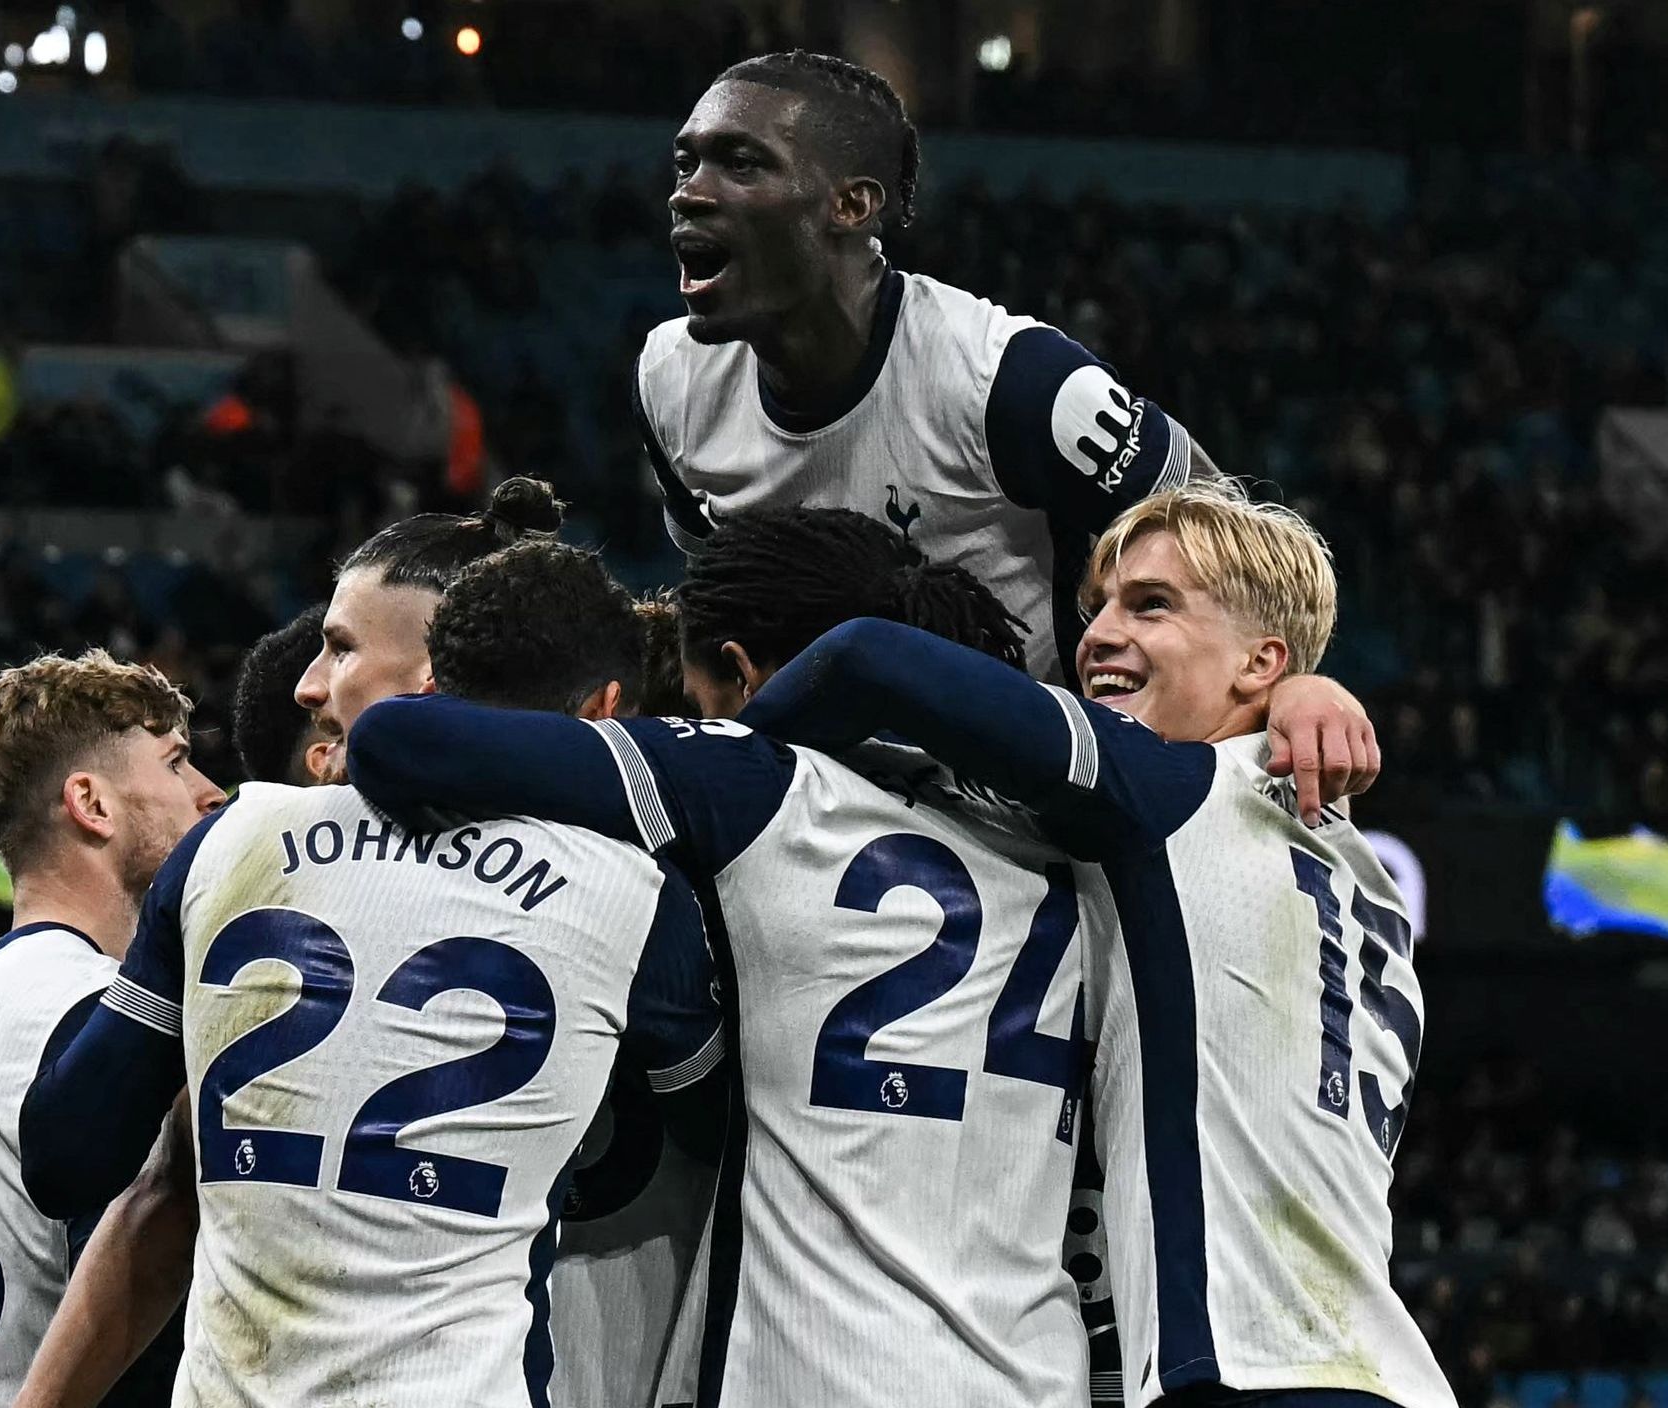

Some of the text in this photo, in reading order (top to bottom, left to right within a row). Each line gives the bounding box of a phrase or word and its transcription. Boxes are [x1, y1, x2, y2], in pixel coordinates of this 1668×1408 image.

[282, 819, 568, 912] JOHNSON
[809, 832, 1084, 1146] 24
[1292, 845, 1425, 1155] 15
[198, 907, 557, 1218] 22
